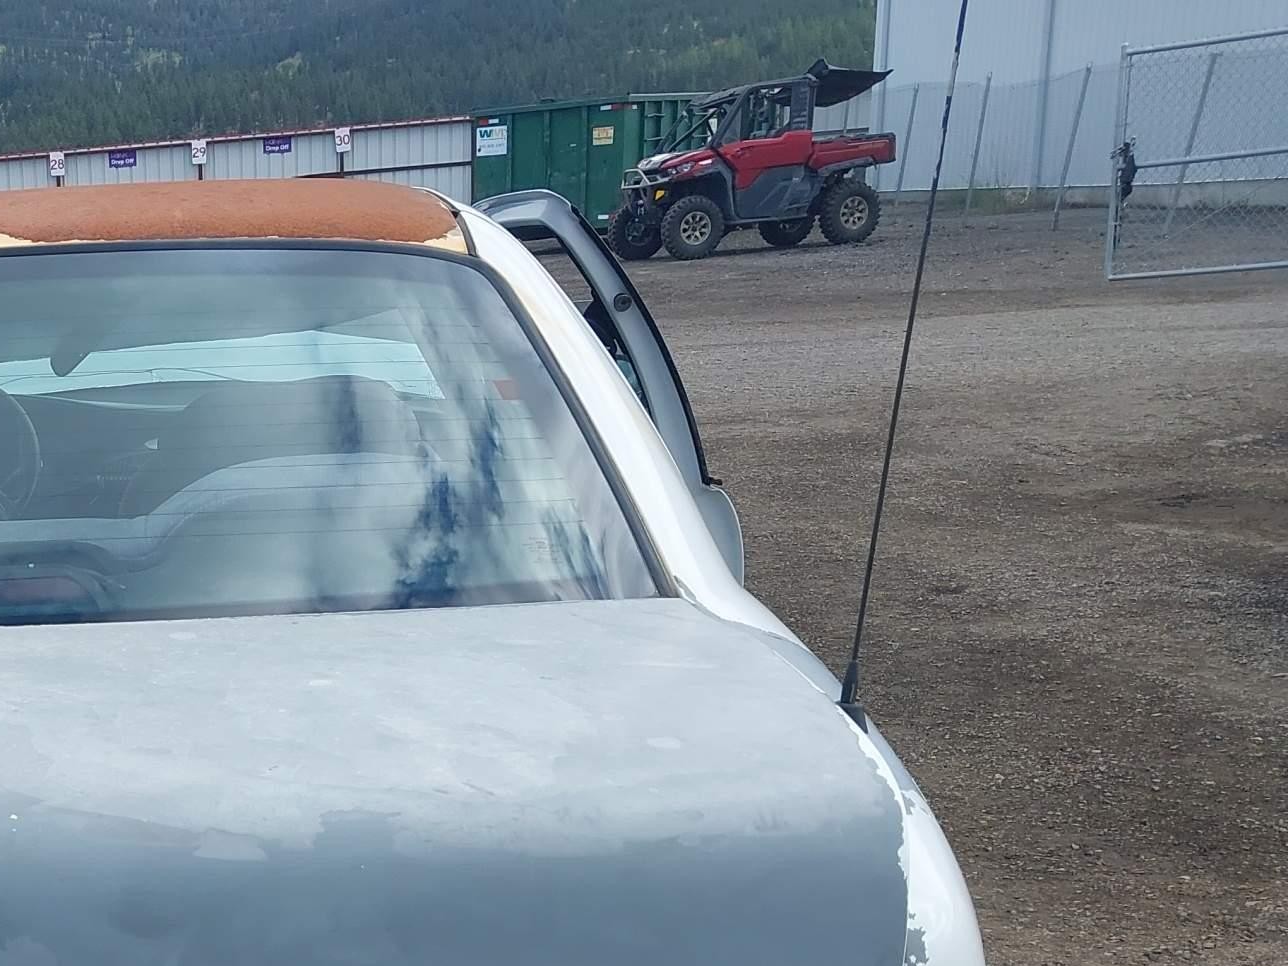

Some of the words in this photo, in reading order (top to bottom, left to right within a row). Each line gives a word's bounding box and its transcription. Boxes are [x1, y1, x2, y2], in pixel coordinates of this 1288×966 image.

[335, 134, 351, 146] 30
[192, 146, 207, 158] 29
[50, 159, 64, 170] 28
